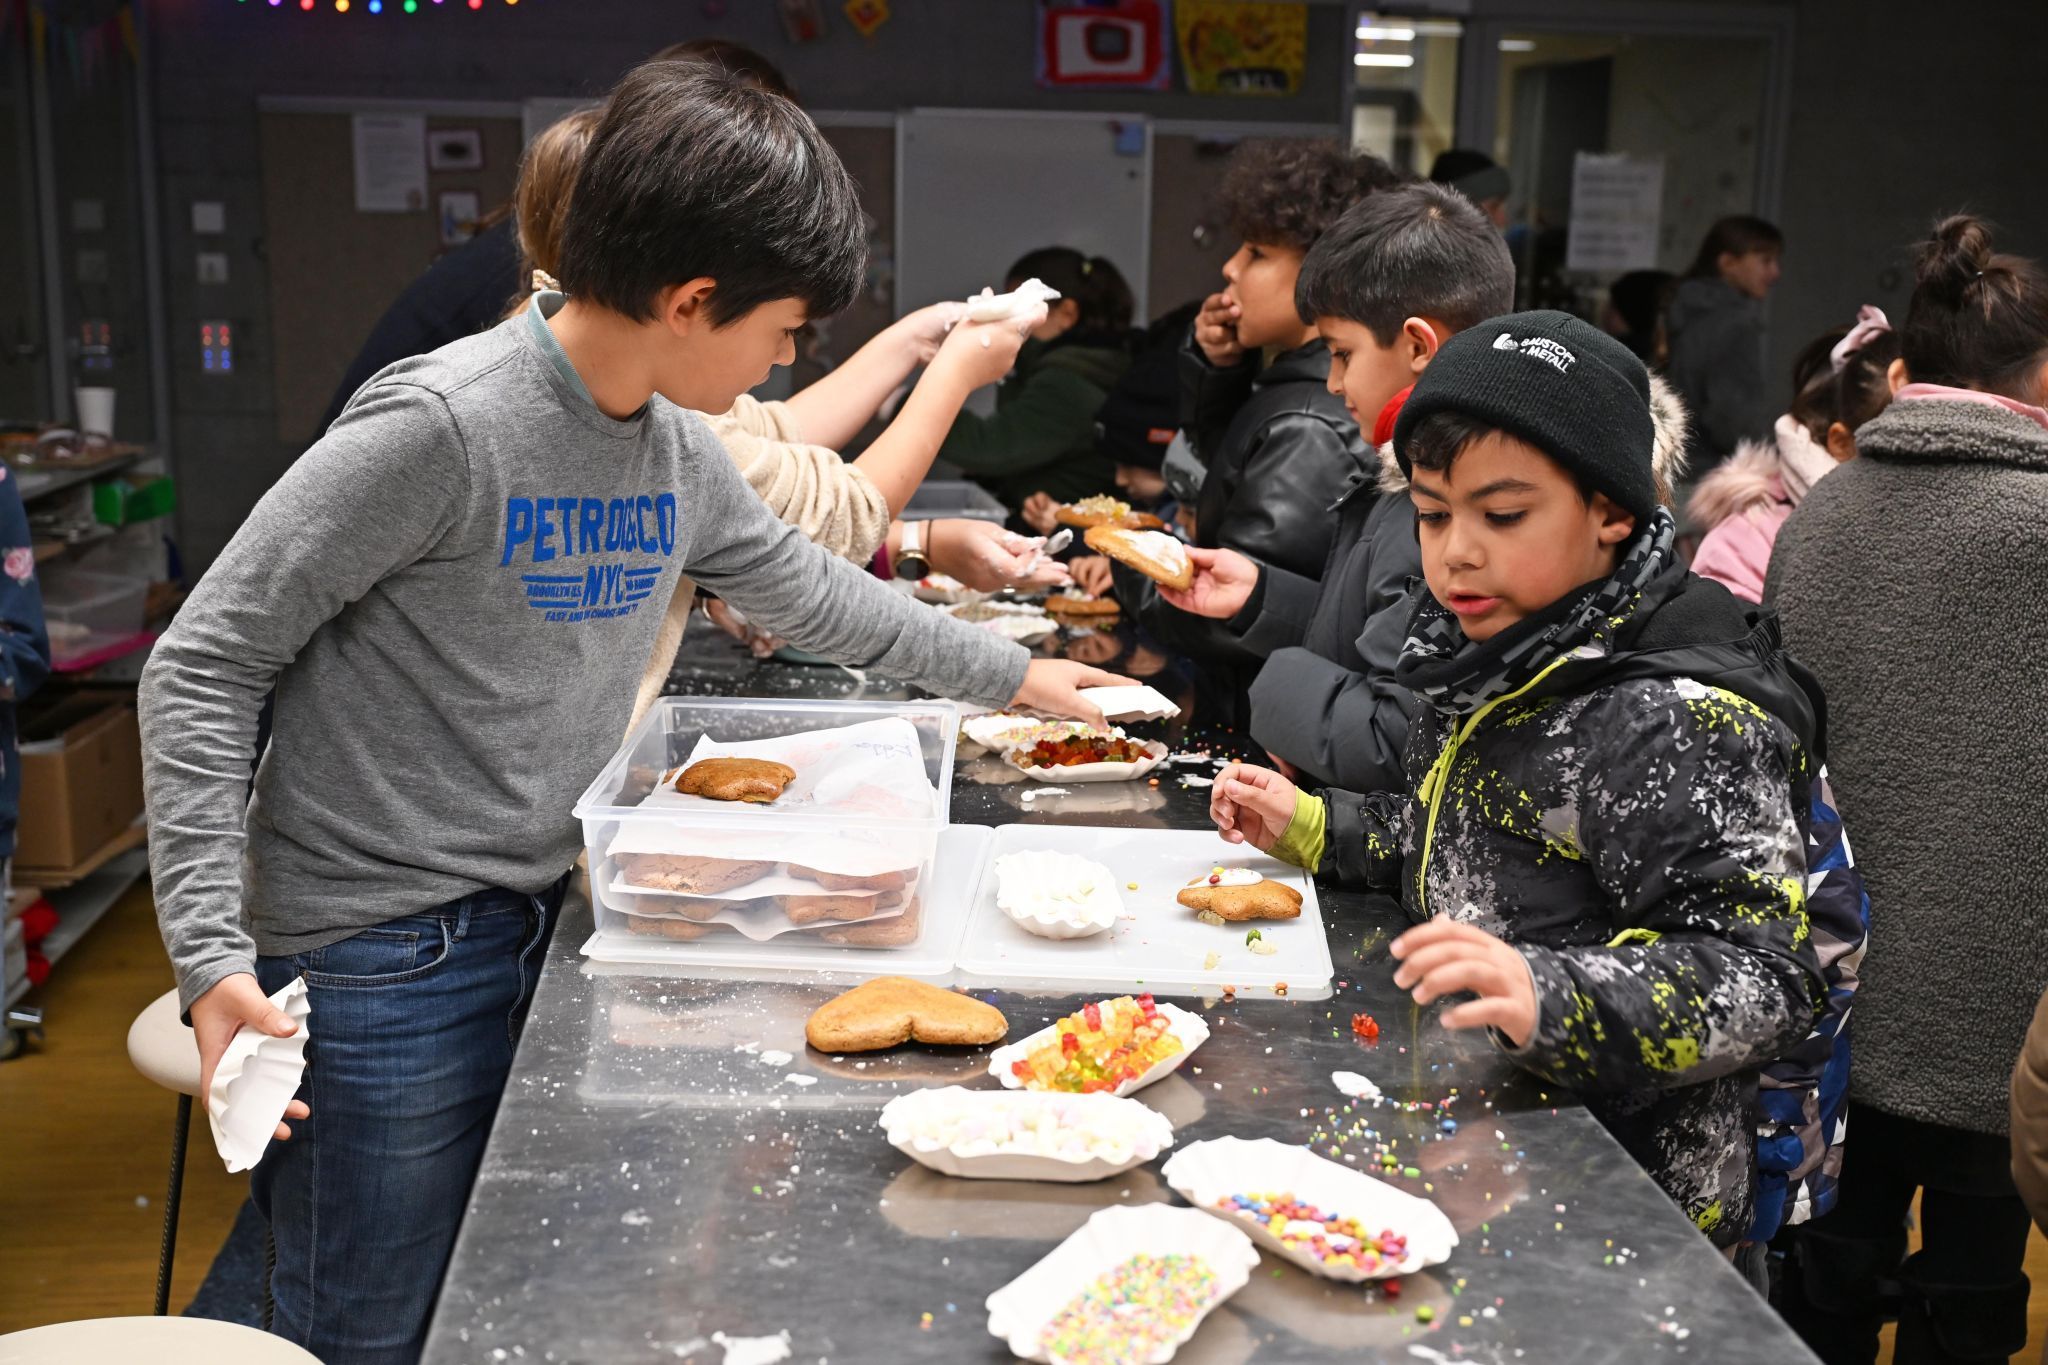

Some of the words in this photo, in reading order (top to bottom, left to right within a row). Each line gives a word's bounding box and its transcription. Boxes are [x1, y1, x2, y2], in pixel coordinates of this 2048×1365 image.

[1520, 337, 1576, 363] BAUSTOFF
[1527, 345, 1568, 373] METALL
[582, 563, 624, 606] NYC
[545, 611, 567, 622] FAST
[567, 610, 583, 622] AND
